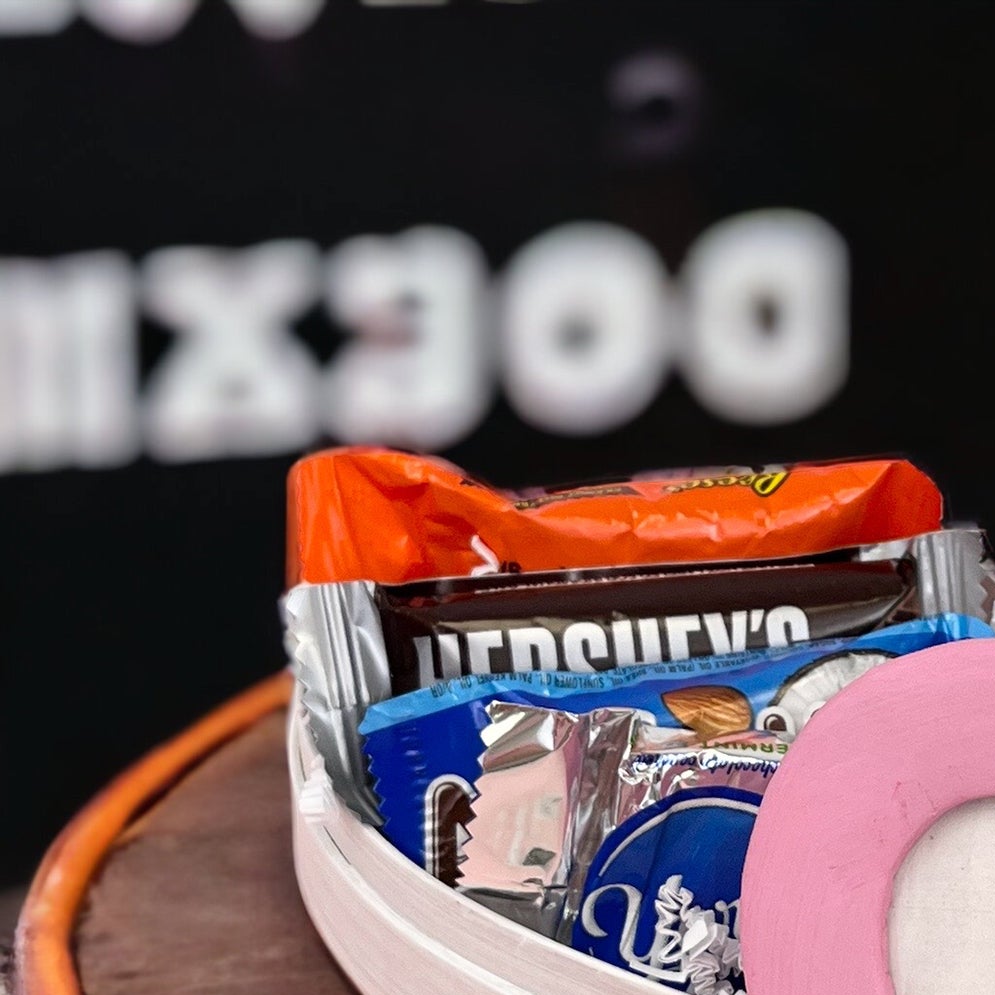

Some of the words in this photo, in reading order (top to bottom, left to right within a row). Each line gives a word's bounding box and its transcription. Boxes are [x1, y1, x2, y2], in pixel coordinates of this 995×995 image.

[509, 672, 532, 684] PALM
[554, 673, 604, 689] SUNFLOWER
[701, 741, 788, 754] ERMINT
